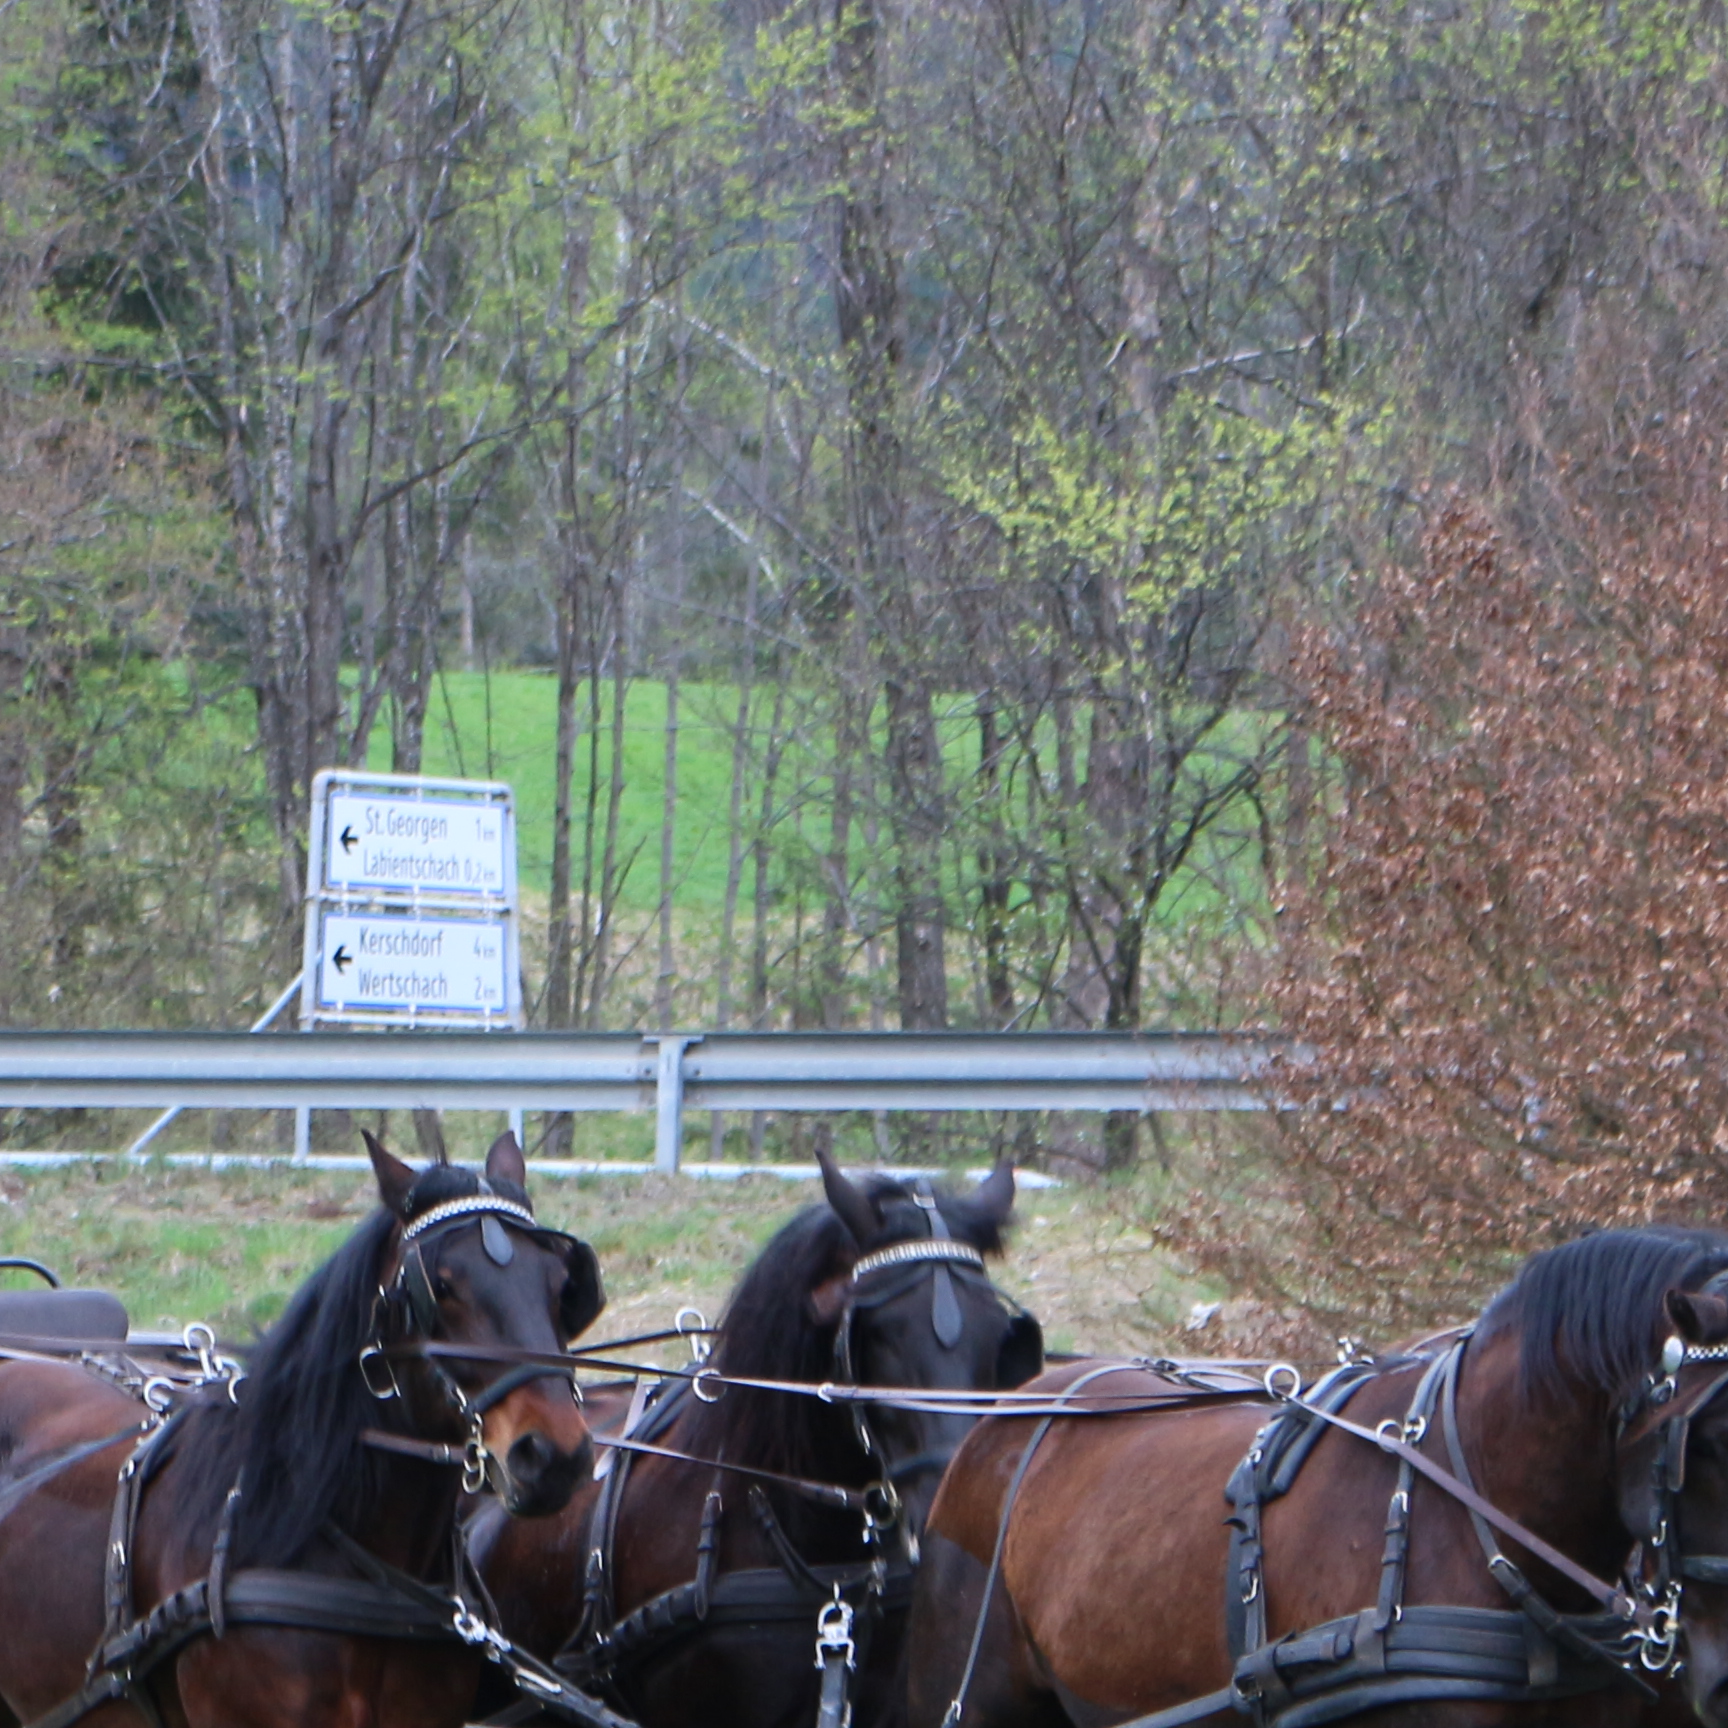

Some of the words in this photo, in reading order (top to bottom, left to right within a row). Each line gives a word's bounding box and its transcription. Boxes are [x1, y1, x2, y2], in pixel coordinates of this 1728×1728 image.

[386, 807, 448, 844] Georgen
[475, 817, 481, 841] 1
[483, 828, 495, 841] km
[363, 848, 460, 882] Labientschach
[463, 858, 482, 885] 0,2
[483, 868, 495, 882] km
[359, 926, 444, 957] Kerschdorf
[473, 936, 481, 958] 4
[483, 945, 496, 958] km
[359, 968, 448, 1000] Wertschach
[475, 977, 482, 1001] 2
[483, 986, 496, 1000] km
